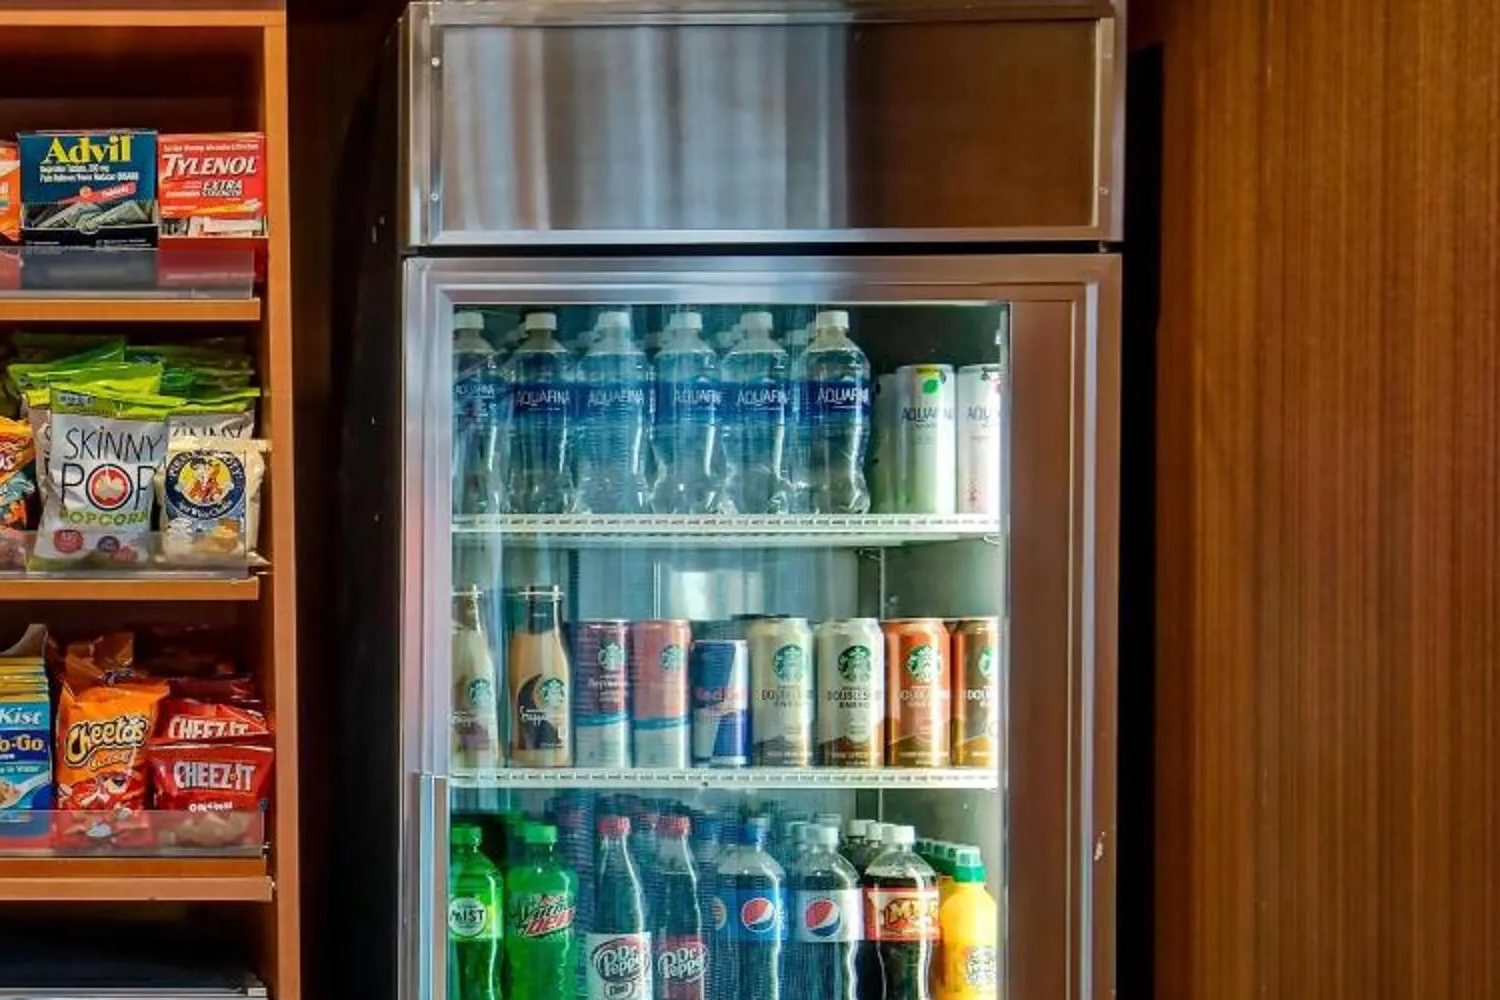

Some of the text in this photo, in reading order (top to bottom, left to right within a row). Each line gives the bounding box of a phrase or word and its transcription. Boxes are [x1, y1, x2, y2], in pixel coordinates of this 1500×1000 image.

[43, 134, 134, 165] Advil
[162, 153, 258, 180] TYLENOL
[202, 180, 243, 191] EXTRA
[63, 425, 165, 462] SKINNY
[62, 508, 149, 527] POPCORN
[65, 712, 148, 769] Cheetos
[173, 759, 257, 791] CHEEZ-IT
